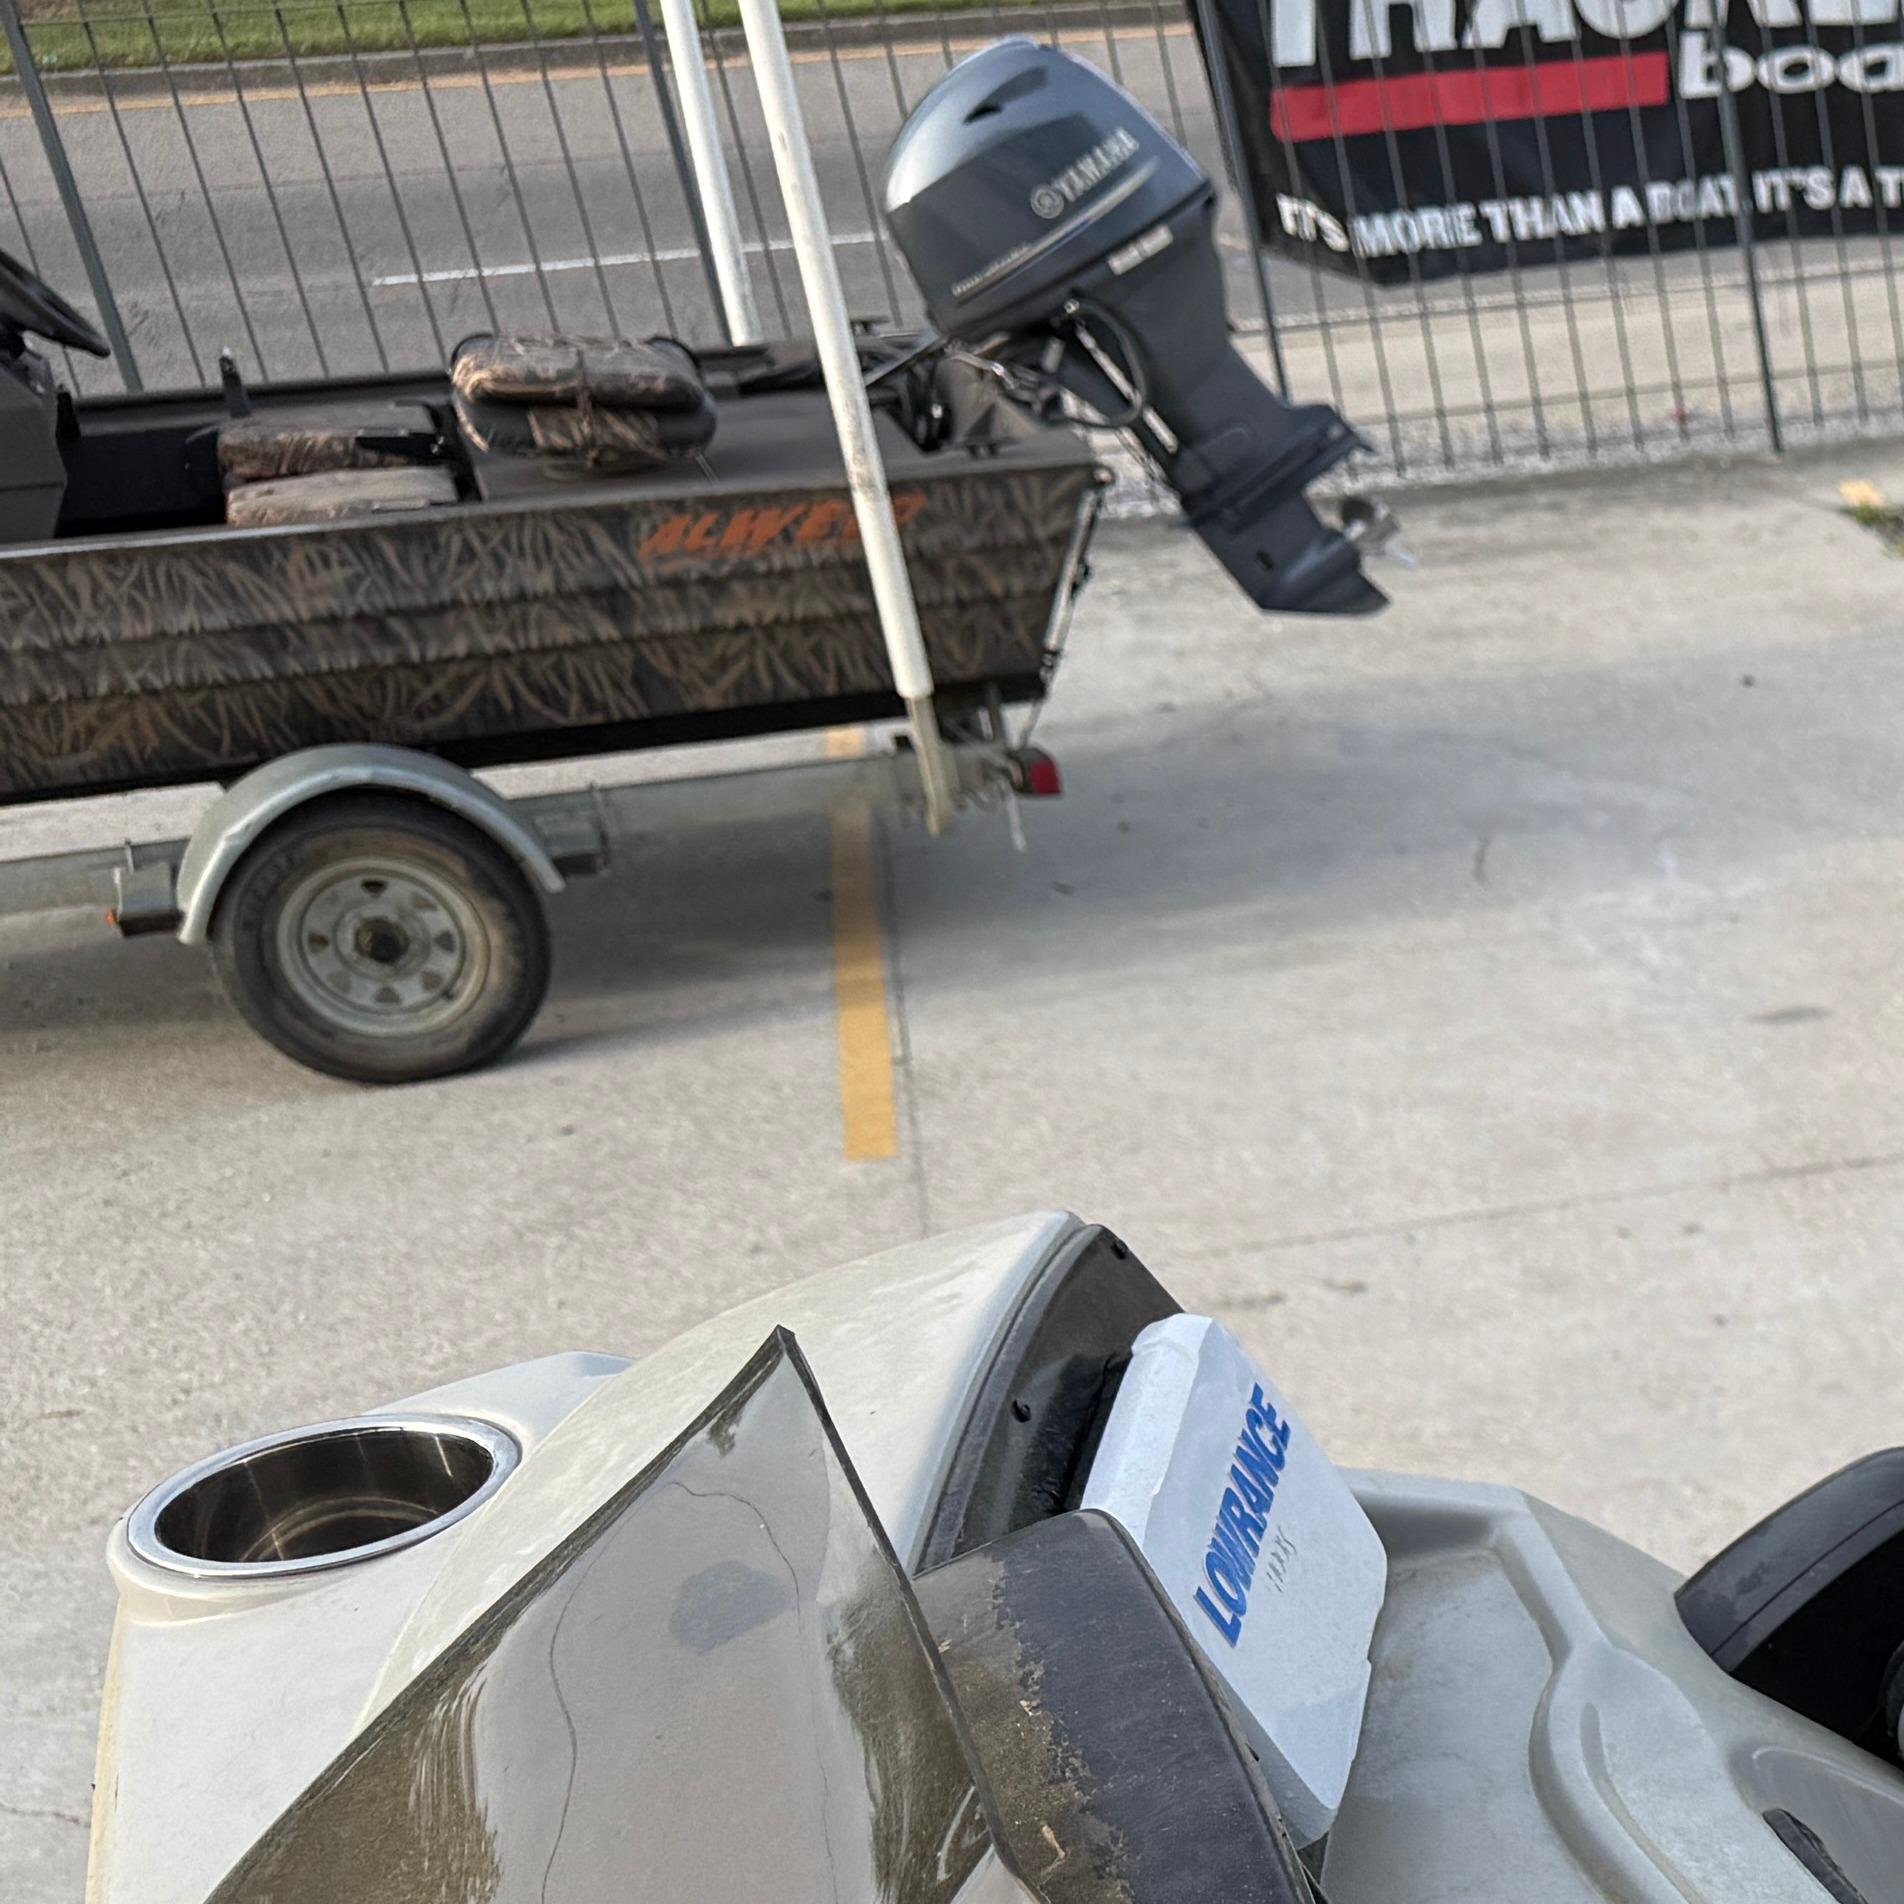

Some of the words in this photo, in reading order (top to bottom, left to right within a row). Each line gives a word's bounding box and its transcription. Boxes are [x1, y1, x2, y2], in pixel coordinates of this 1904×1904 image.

[1350, 202, 1483, 259] MORE
[1480, 190, 1606, 243] THAN
[1611, 184, 1645, 230] A
[1841, 165, 1872, 209] A
[1192, 1382, 1291, 1648] LOWRANCE
